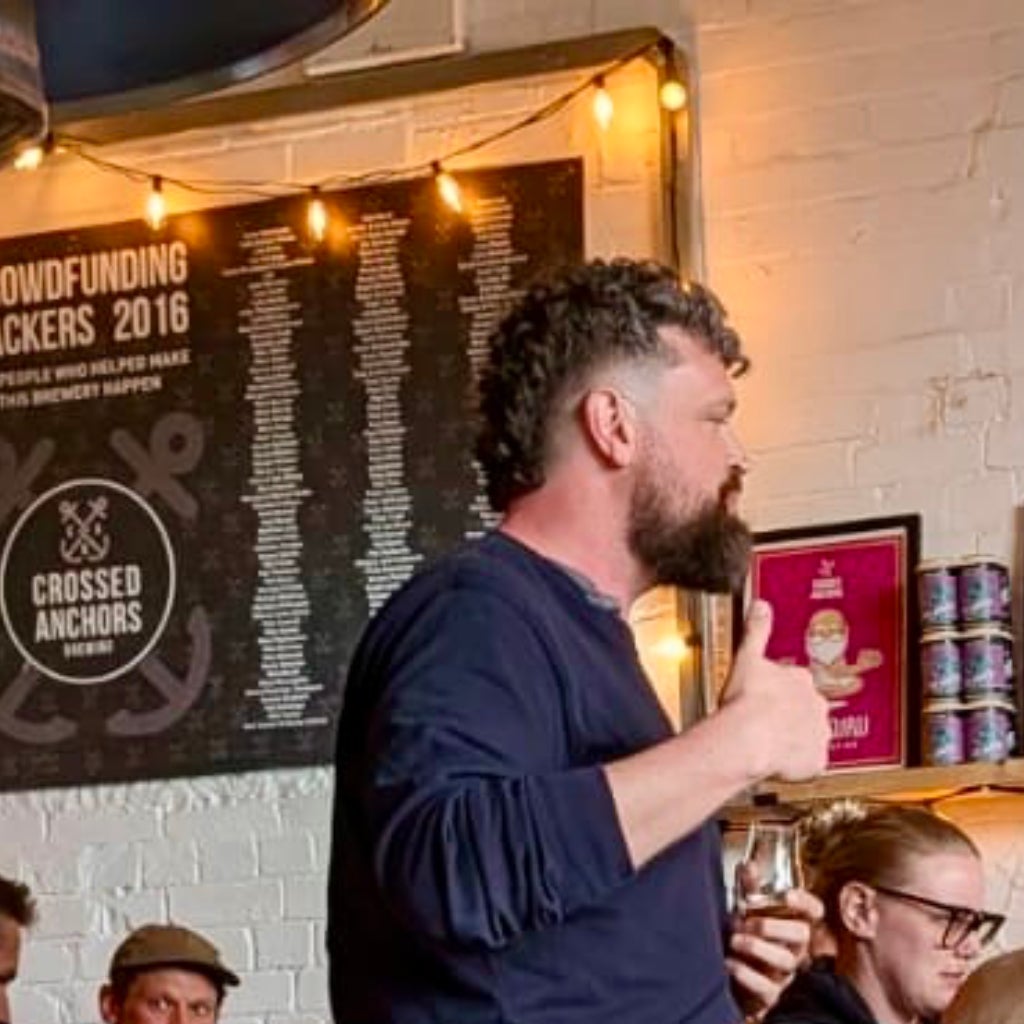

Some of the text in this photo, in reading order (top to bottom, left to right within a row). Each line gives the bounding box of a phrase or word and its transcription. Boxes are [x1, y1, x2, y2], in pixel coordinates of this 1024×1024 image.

[0, 241, 188, 307] OWDFUNDING
[0, 290, 190, 356] CKERS 2016
[55, 362, 87, 380] WHO
[91, 355, 146, 374] HELPED
[150, 348, 191, 366] MAKE
[33, 383, 100, 406] BREWERY
[103, 375, 162, 396] HAPPEN
[32, 564, 141, 606] CROSSED
[36, 600, 142, 642] ANCHORS
